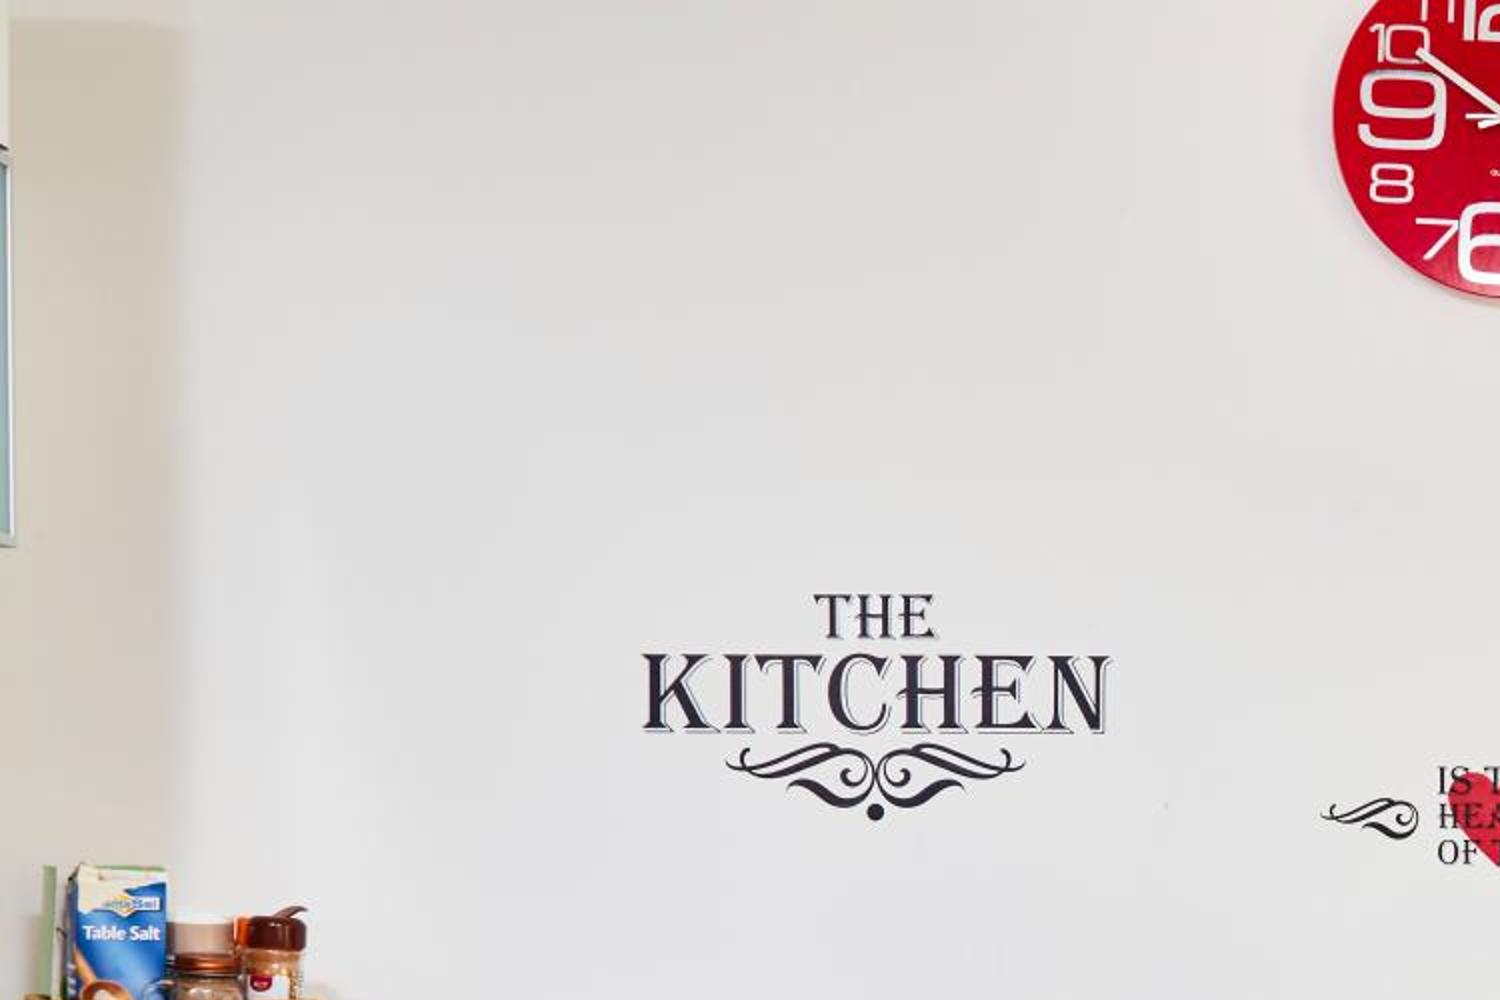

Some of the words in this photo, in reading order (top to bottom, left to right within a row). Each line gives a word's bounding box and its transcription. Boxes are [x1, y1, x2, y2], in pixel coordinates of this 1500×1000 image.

[1369, 23, 1431, 65] 10
[1358, 69, 1448, 151] 9
[1369, 162, 1415, 204] 8
[1415, 217, 1460, 260] 7
[813, 593, 939, 640] THE
[641, 653, 1114, 735] KITCHEN
[1437, 765, 1473, 796] IS
[1437, 839, 1480, 865] OF
[82, 925, 127, 941] Table
[129, 925, 161, 941] Salt
